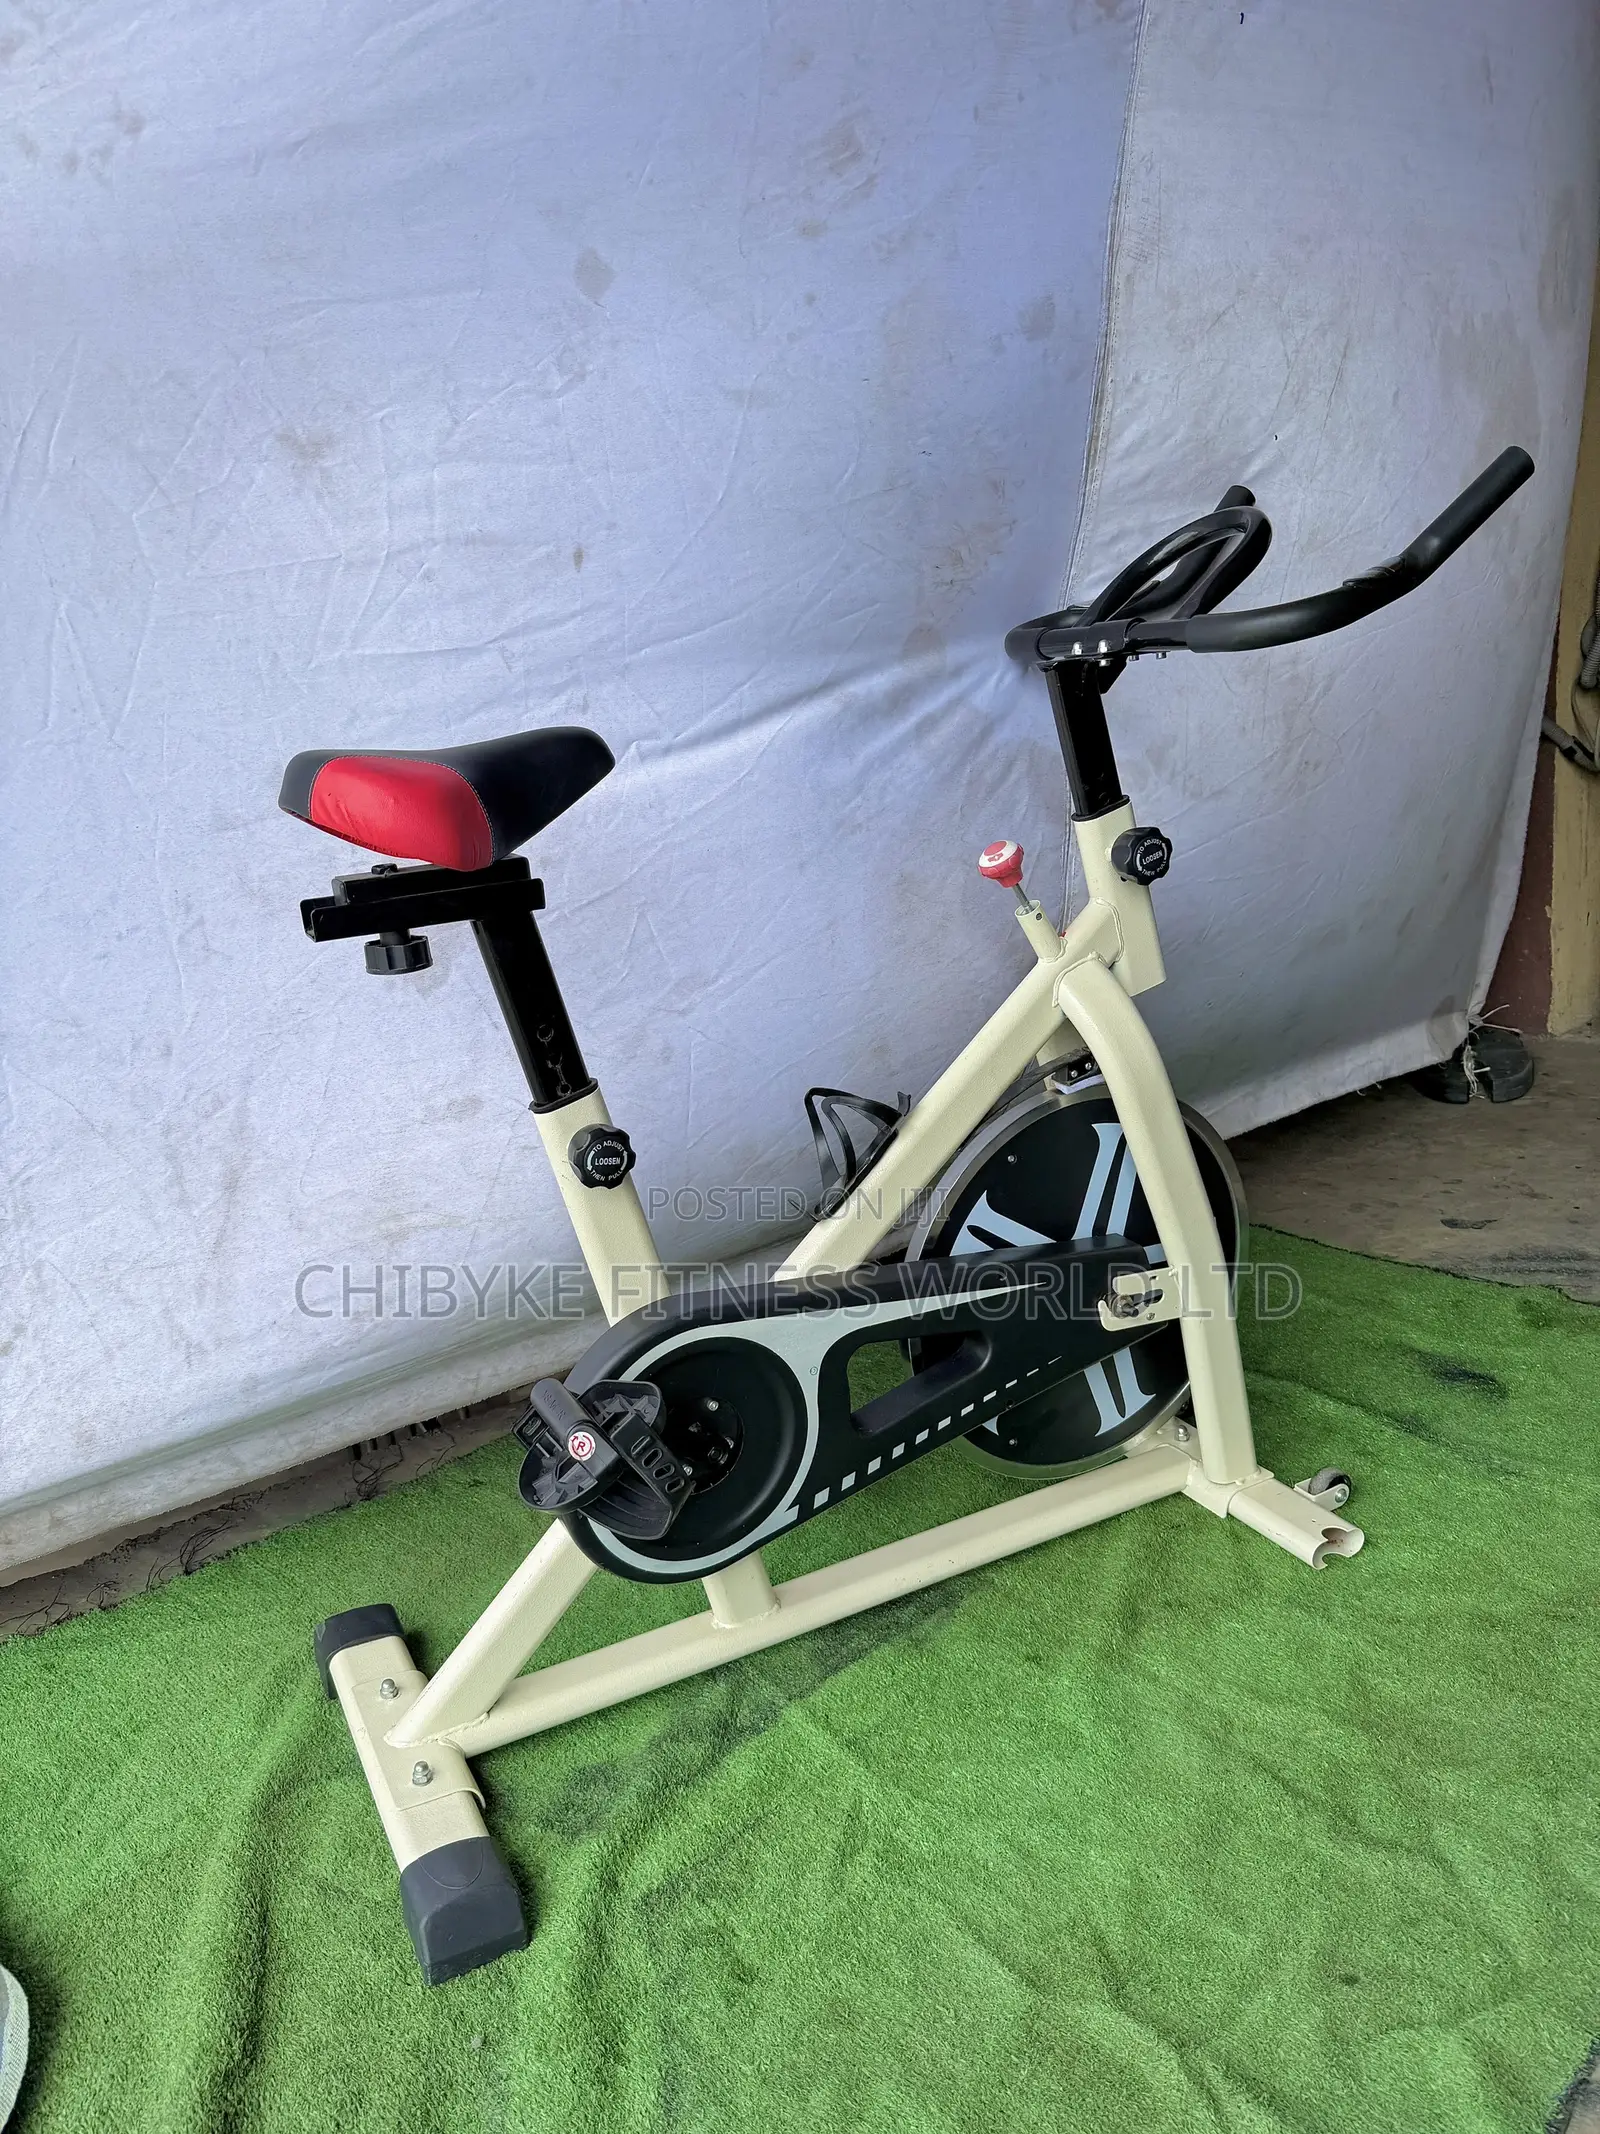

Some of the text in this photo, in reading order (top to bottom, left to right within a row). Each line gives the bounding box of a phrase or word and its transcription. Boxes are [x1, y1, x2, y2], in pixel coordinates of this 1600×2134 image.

[1137, 838, 1162, 854] TO ADJUST
[1142, 850, 1163, 865] LOOSEN
[593, 1140, 625, 1153] TO ADJUST
[595, 1157, 621, 1166] LOOSEN
[590, 1169, 623, 1181] THEN PULL
[576, 1441, 586, 1452] R
